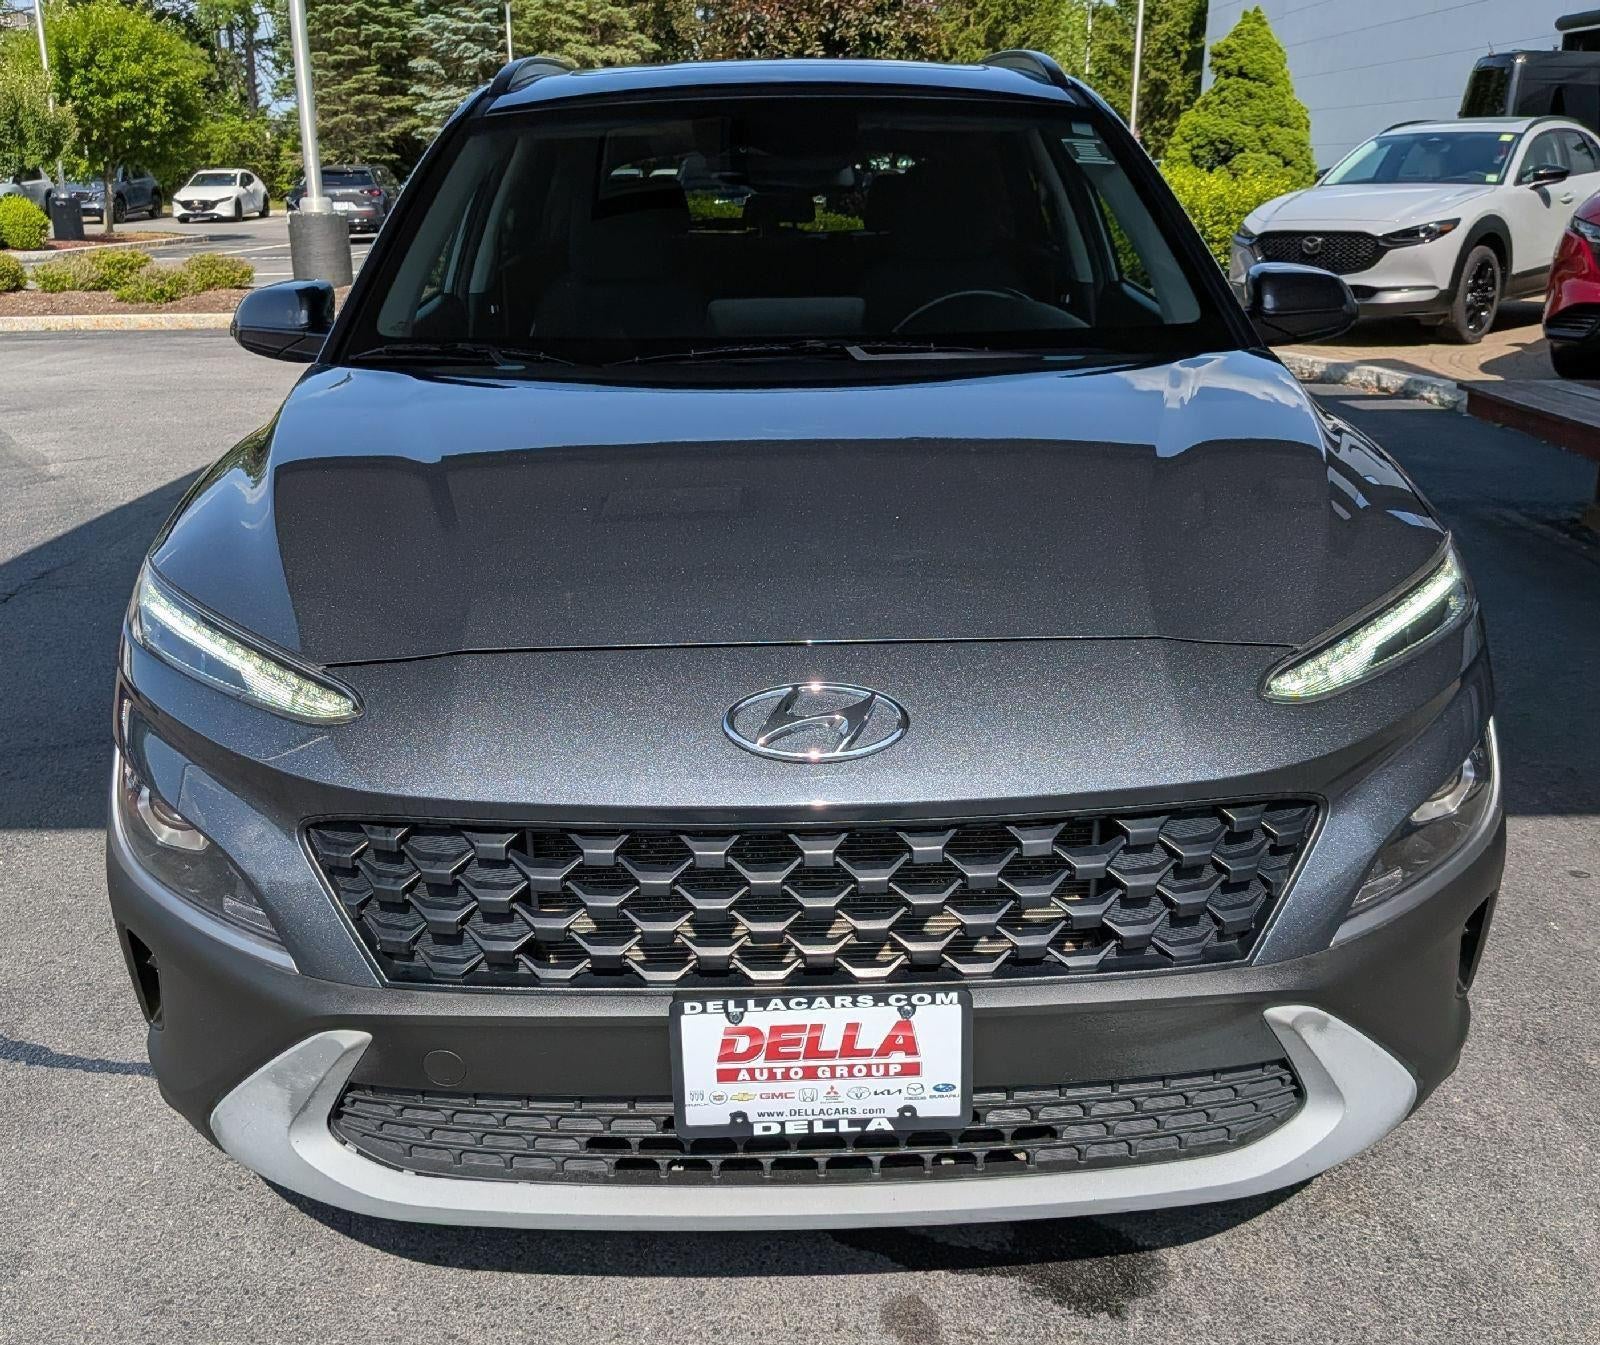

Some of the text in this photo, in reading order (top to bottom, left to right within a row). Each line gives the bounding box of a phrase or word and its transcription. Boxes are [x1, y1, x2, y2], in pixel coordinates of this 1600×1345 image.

[683, 991, 959, 1015] DELLACARS.COM
[717, 1019, 921, 1064] DELLA
[737, 1064, 902, 1081] AUTO GROUP
[759, 1091, 796, 1100] GMC
[756, 1107, 886, 1118] www.DELLACARS.com
[753, 1117, 895, 1136] DELLA
